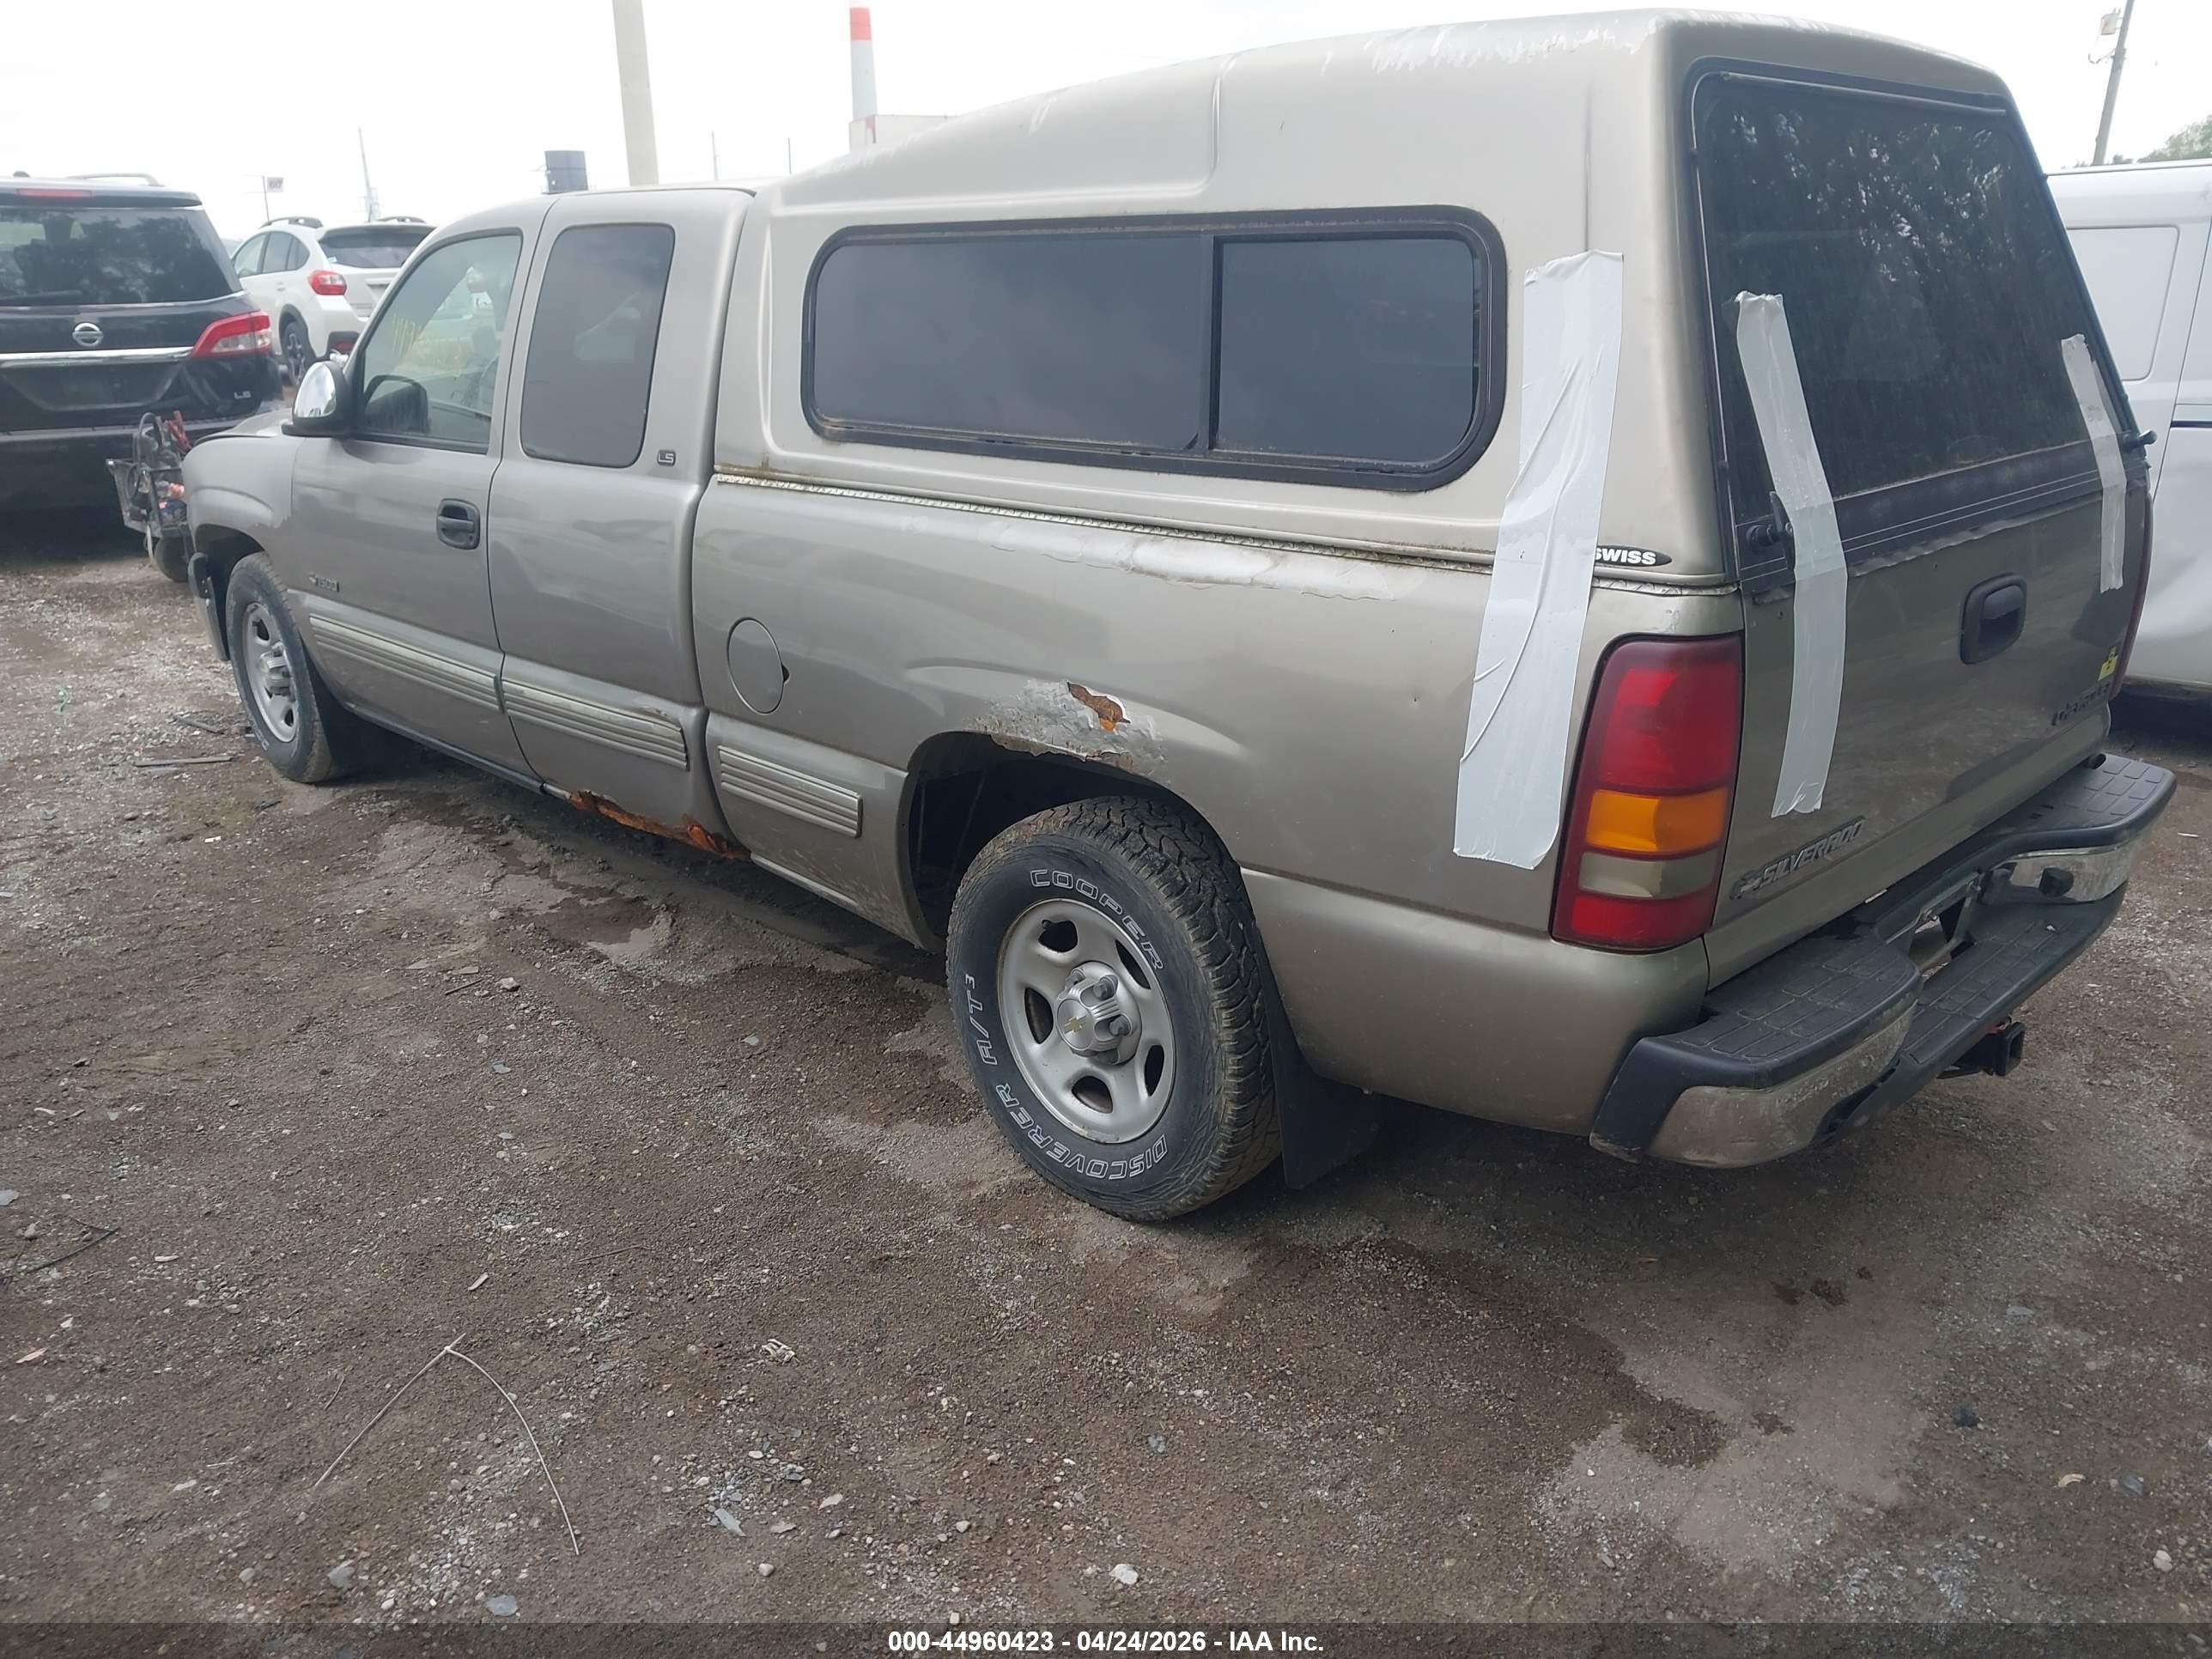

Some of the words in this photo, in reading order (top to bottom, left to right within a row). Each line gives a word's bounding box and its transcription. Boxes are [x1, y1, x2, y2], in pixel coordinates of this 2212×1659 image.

[658, 453, 674, 463] LS
[1760, 818, 1866, 888] SILVERADO
[1030, 869, 1164, 969] COOPER
[995, 1083, 1169, 1181] DISCOVERER
